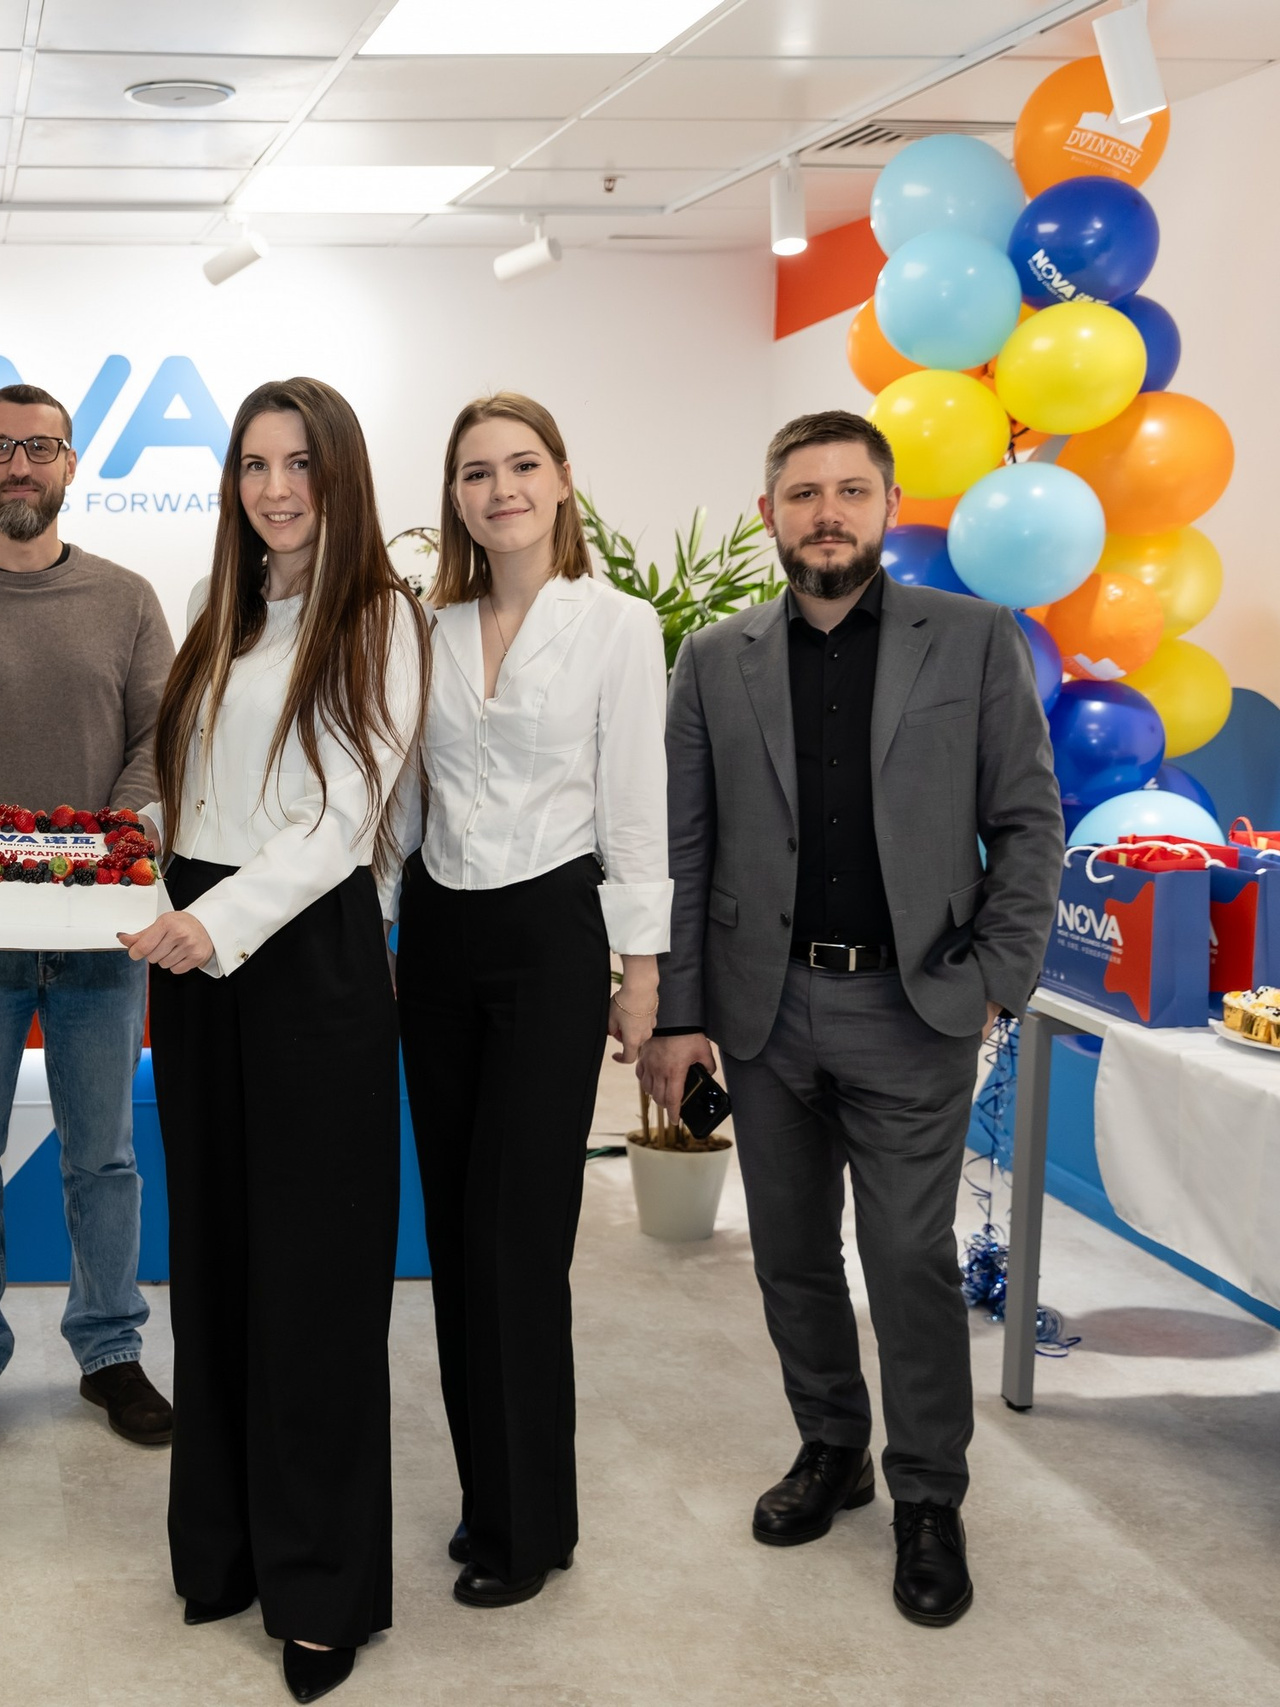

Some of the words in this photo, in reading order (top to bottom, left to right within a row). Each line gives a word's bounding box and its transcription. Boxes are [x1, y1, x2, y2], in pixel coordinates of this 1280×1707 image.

[1065, 129, 1142, 168] DVINTSEV
[1032, 248, 1077, 299] NOVA
[86, 492, 221, 513] FORWAR
[4, 849, 100, 859] ПОЖАЛОВАТЬ
[1057, 899, 1124, 947] NOVA
